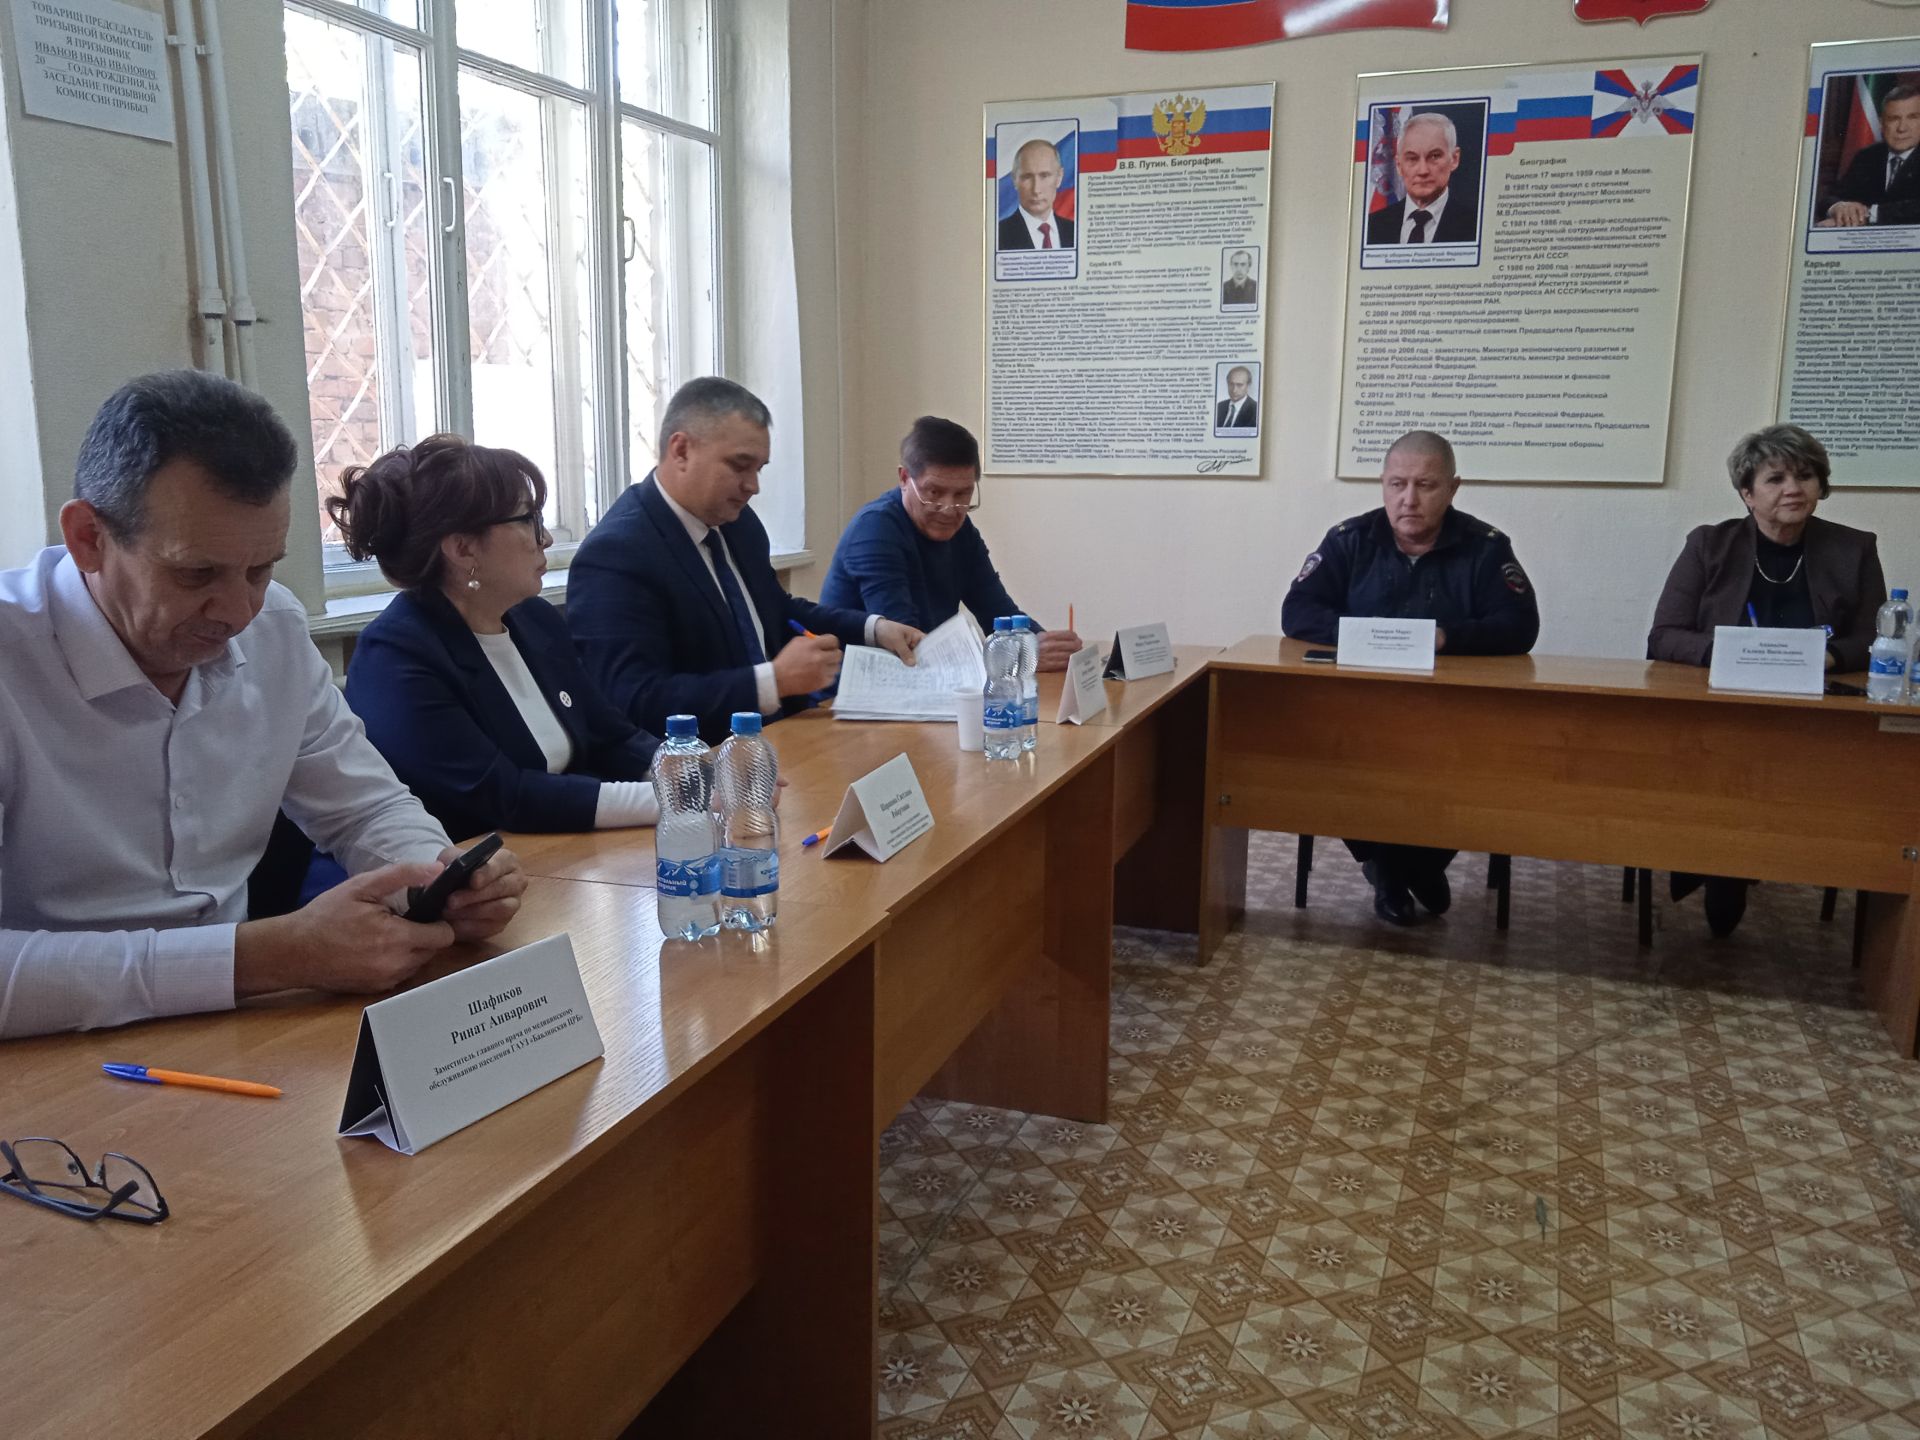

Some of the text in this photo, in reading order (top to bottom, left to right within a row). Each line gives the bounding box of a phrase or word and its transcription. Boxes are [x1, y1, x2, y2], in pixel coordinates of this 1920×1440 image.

[32, 1, 154, 41] ТОВАРИЩ ПРЕДСЕДАТЕЛЬ
[35, 15, 98, 39] ПРИЗЫВНОЙ
[35, 41, 78, 60] ИВАНОВ
[80, 52, 107, 67] ИВАН
[66, 36, 132, 60] Я ПРИЗЫВНИК
[43, 70, 157, 104] ЗАСЕДАНИЕ ПРИЗЫВНОЙ
[67, 62, 94, 77] ГОДА
[148, 82, 161, 93] НА
[56, 86, 149, 114] КОМИССИИ ПРИБЫЛ
[1119, 156, 1224, 171] В.В. Путин. Биография.
[1804, 260, 1840, 268] Карьера
[467, 986, 523, 1016] Шафиков
[451, 994, 549, 1045] Ринат Анварович
[434, 1008, 574, 1076] Заместитель главного врача по медицинскому
[429, 1064, 479, 1092] обслуживанию
[479, 1049, 511, 1068] населения
